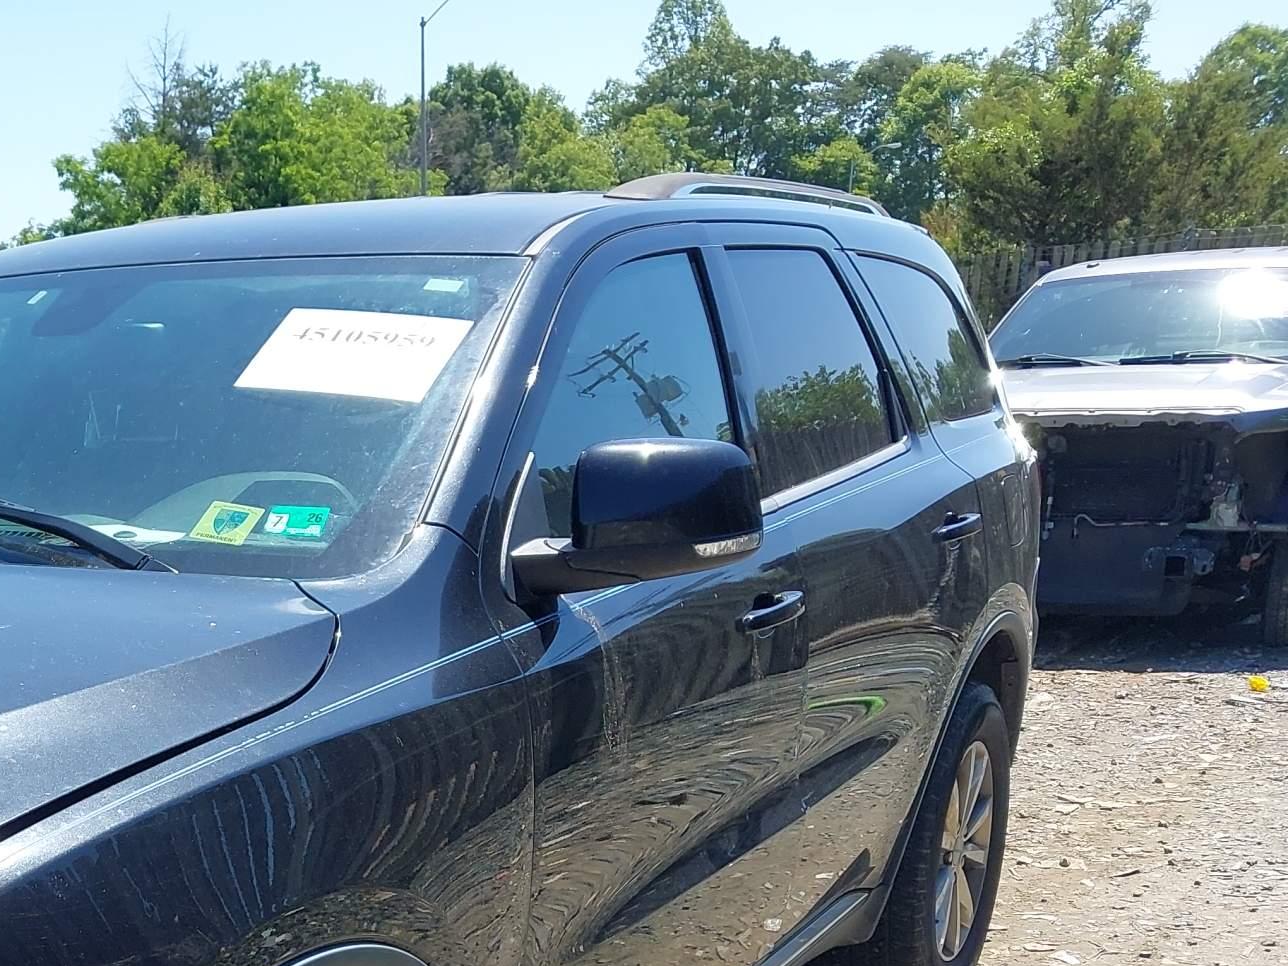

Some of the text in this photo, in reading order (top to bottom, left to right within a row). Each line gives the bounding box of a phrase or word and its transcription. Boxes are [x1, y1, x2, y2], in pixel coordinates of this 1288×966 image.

[292, 326, 436, 347] 45105959
[273, 515, 284, 527] 7
[307, 512, 324, 523] 26
